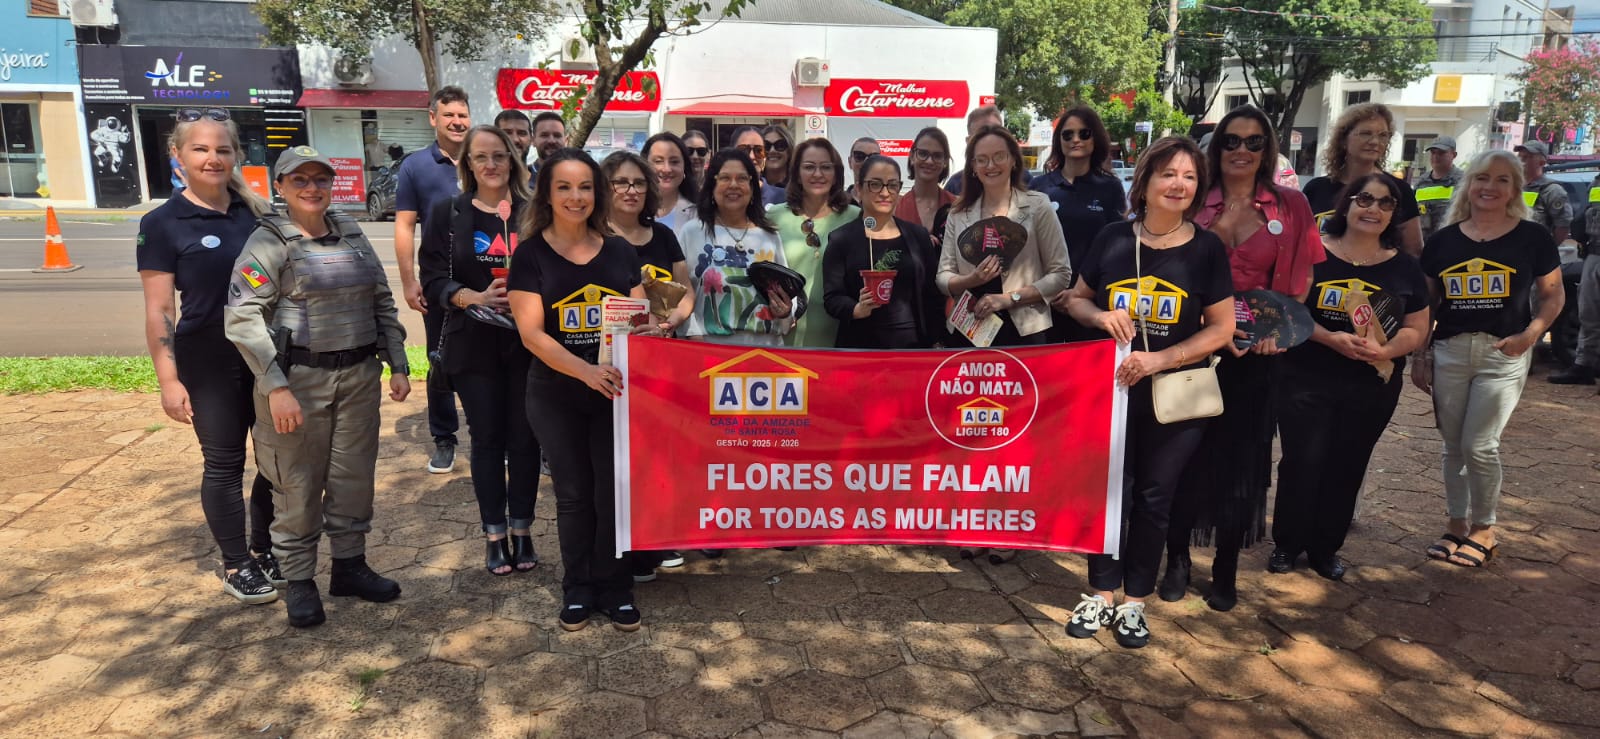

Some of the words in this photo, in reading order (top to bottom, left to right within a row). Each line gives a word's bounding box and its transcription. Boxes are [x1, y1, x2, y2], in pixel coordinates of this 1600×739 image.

[151, 58, 206, 87] ALE
[561, 73, 597, 84] Mal
[515, 77, 646, 106] Catanse
[879, 83, 926, 93] Malhas
[840, 86, 955, 113] Catarinense
[812, 118, 818, 127] E
[1450, 277, 1503, 294] ACA
[1116, 294, 1172, 317] ACA
[565, 308, 600, 326] AC
[958, 362, 1006, 377] AMOR
[719, 381, 799, 407] ACA
[940, 377, 974, 394] NÃO
[980, 381, 1024, 396] MATA
[710, 418, 739, 427] CASA
[743, 418, 759, 427] DA
[762, 418, 811, 427] AMIZADE
[965, 411, 1000, 422] ACA
[738, 428, 768, 436] SANTA
[771, 428, 797, 436] ROSA
[956, 427, 988, 437] LIGUE
[990, 427, 1009, 436] 180
[716, 438, 749, 447] GESTÃO
[780, 439, 800, 447] 2026
[707, 462, 833, 491] FLORES
[843, 462, 912, 494] QUE
[922, 464, 1031, 493] FALAM
[699, 507, 752, 529] POR
[759, 507, 845, 529] TODAS
[852, 507, 887, 529] AS
[895, 508, 1036, 532] MULHERES
